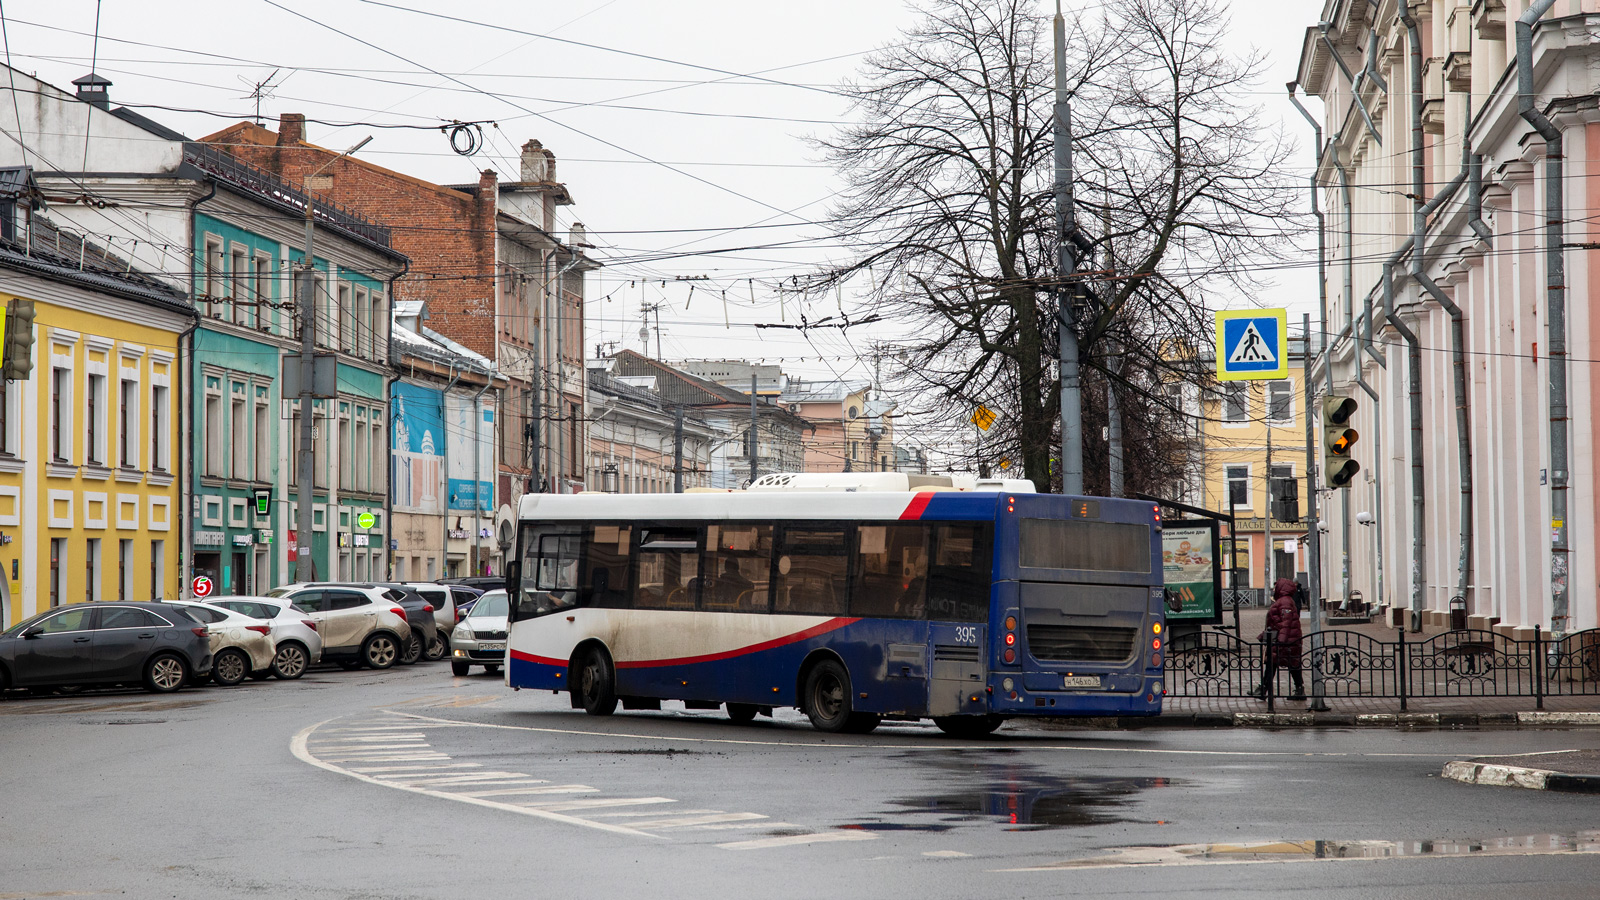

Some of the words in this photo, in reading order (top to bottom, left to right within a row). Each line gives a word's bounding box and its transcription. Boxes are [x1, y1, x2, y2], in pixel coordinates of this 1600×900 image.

[193, 530, 225, 545] НИАГАРА
[196, 578, 208, 594] 5
[955, 626, 976, 643] 395
